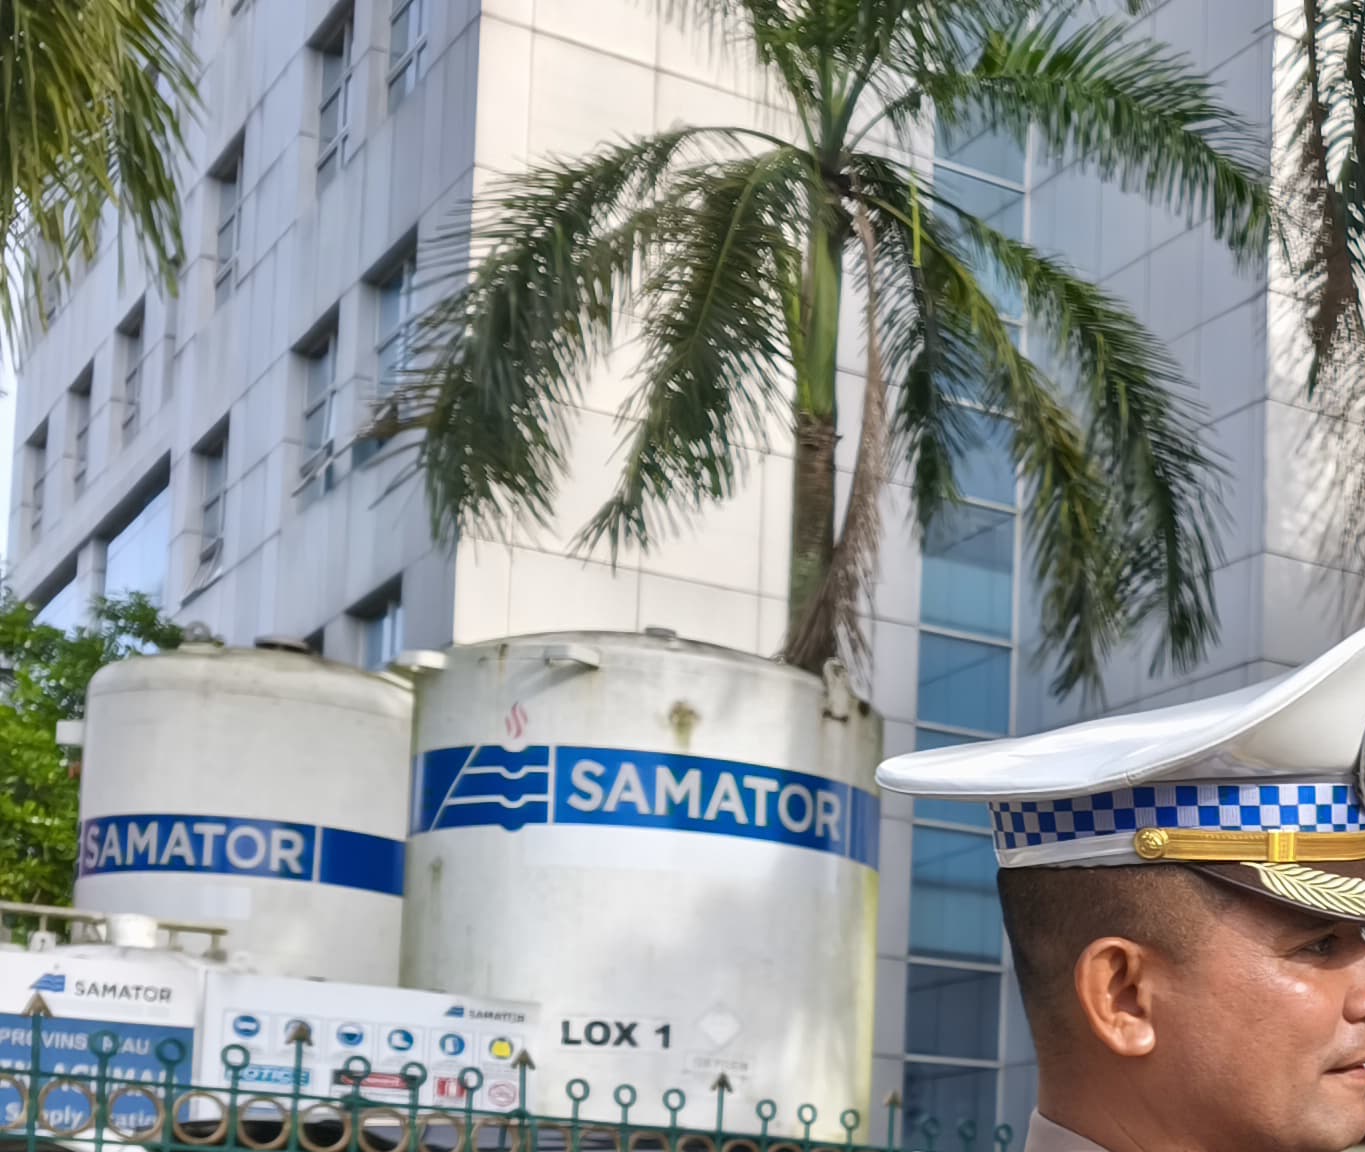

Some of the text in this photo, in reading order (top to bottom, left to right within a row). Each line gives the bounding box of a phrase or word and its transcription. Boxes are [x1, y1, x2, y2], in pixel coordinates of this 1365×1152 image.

[567, 758, 841, 842] SAMATOR
[85, 820, 306, 875] SAMATOR
[74, 980, 173, 1003] SAMATOR
[469, 1009, 526, 1023] SAMATOR
[102, 1035, 149, 1055] RAU
[561, 1020, 672, 1049] LOX 1
